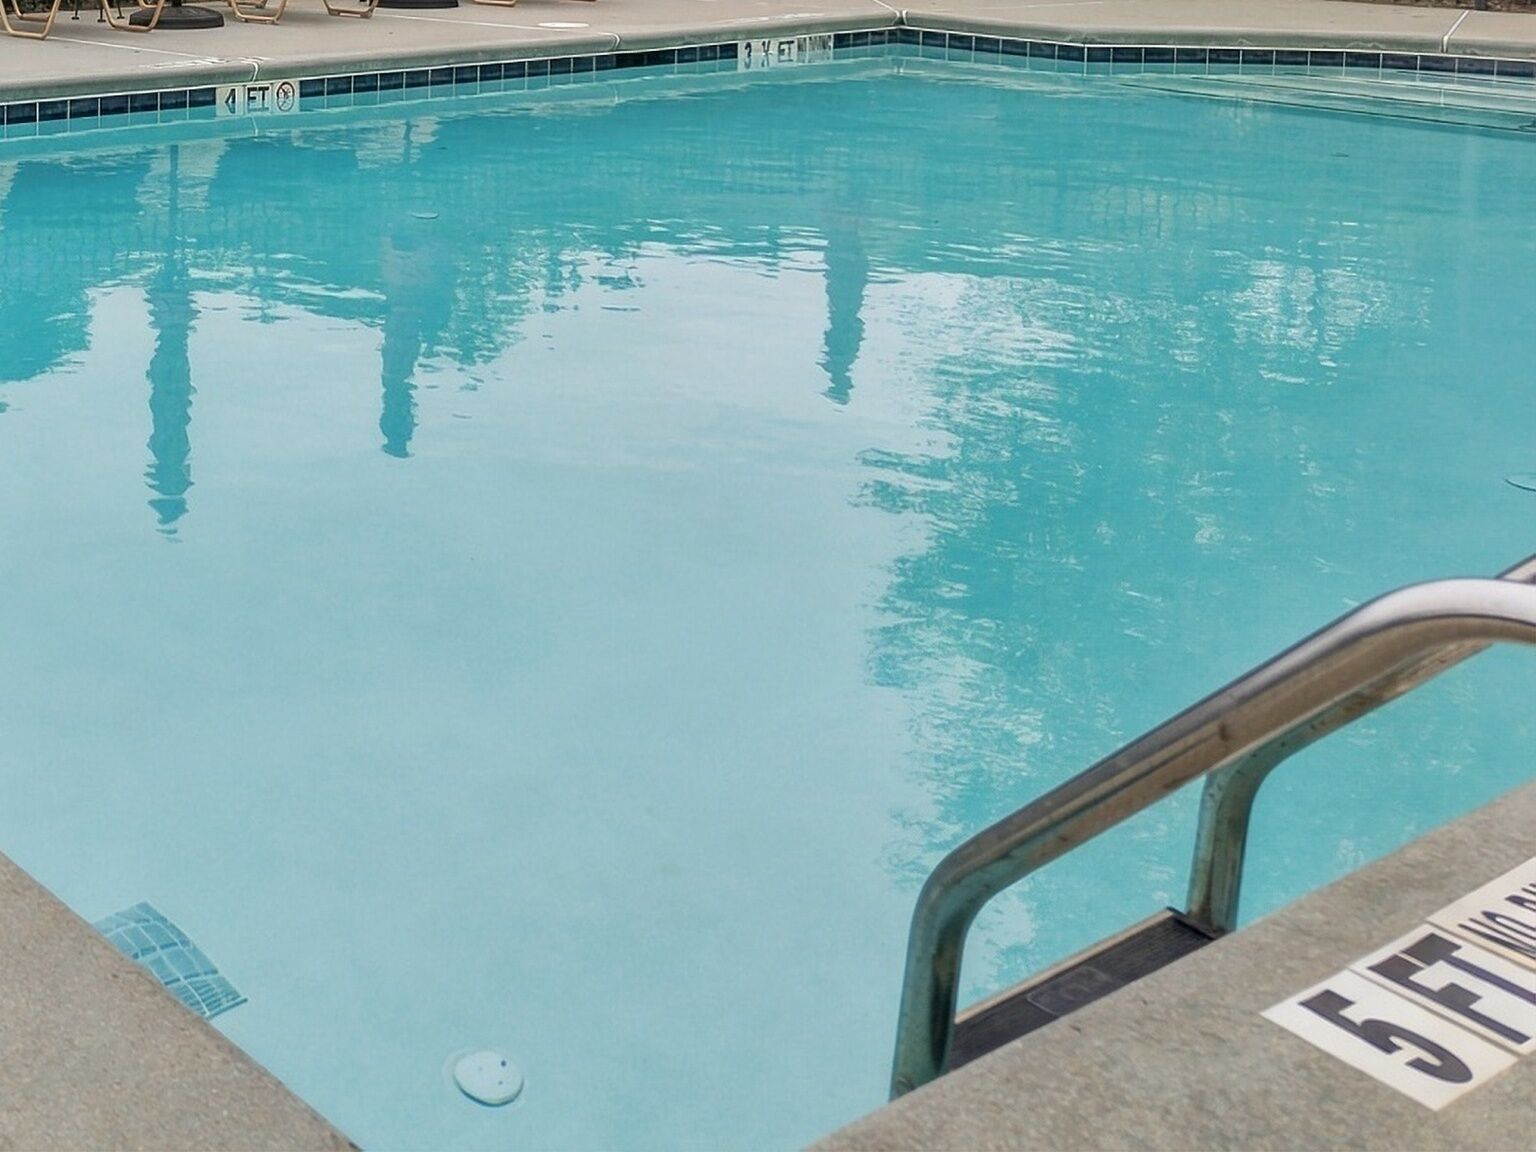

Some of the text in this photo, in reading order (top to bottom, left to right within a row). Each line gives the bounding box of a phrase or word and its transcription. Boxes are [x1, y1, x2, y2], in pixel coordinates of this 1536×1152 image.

[247, 86, 270, 104] FT
[1366, 932, 1536, 1045] FT
[1298, 989, 1473, 1084] 5
